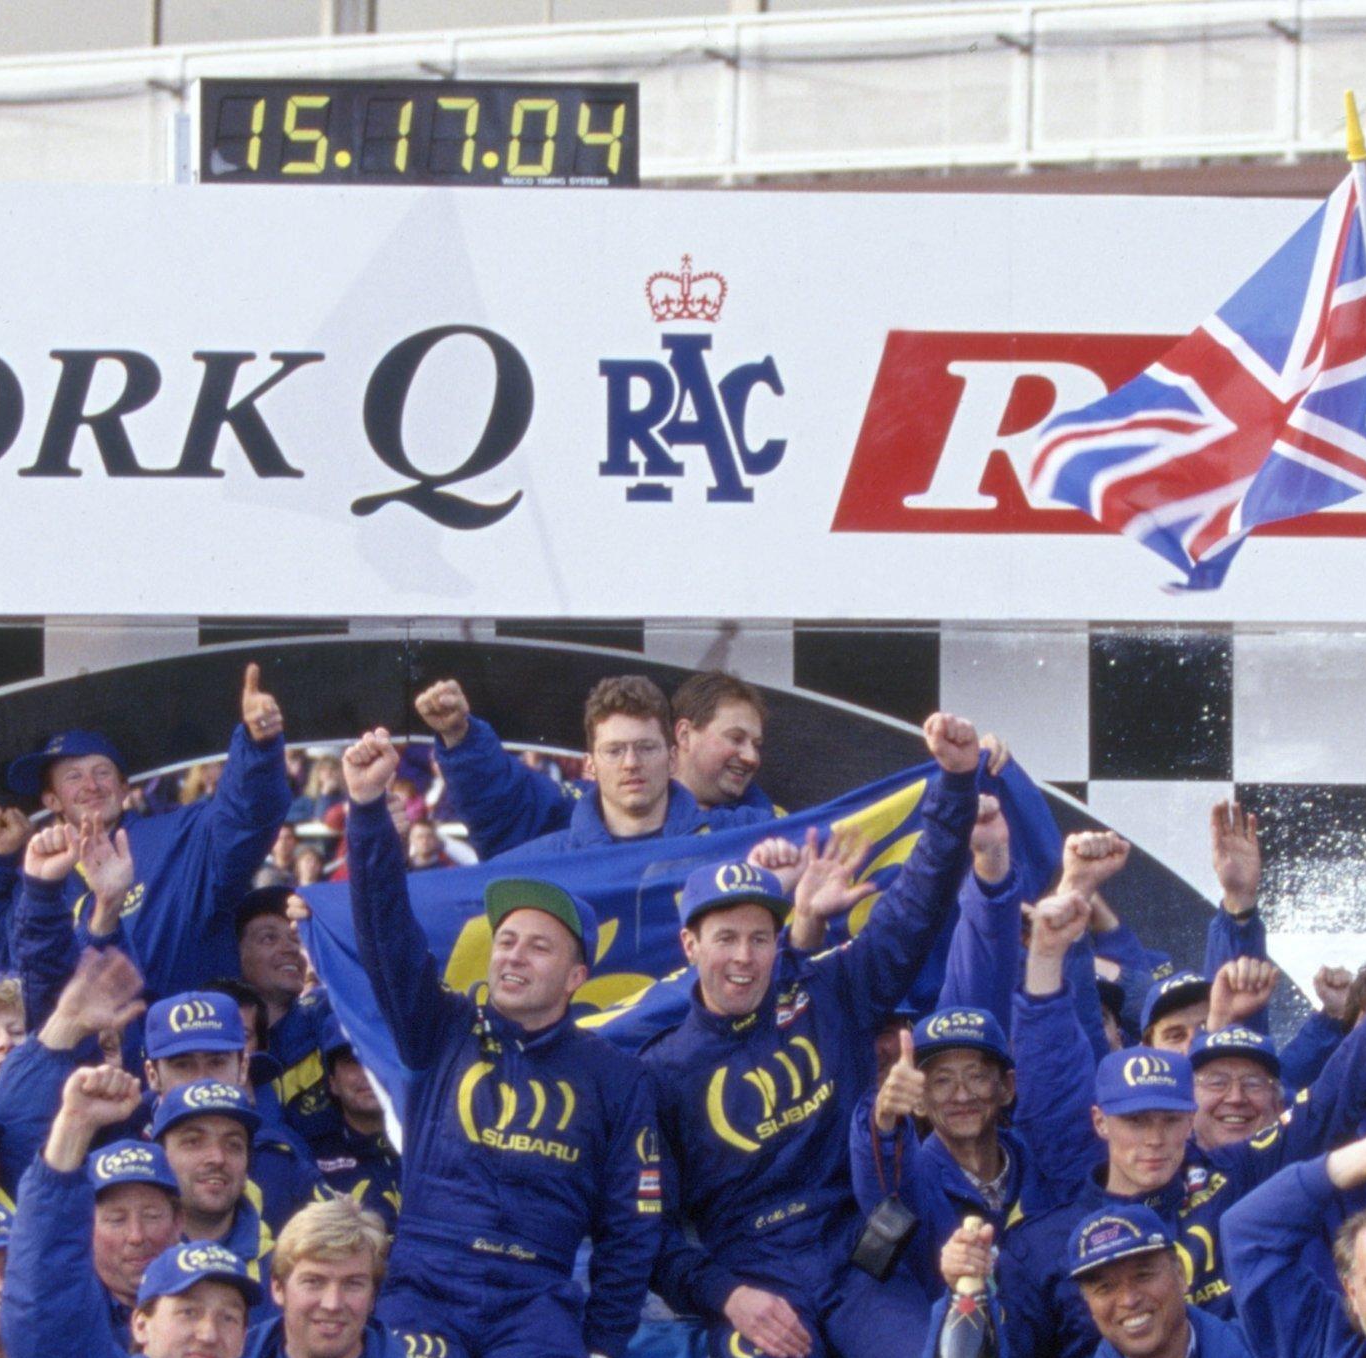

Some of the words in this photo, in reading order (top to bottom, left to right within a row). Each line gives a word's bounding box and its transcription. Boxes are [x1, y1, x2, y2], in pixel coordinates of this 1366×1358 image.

[569, 176, 610, 187] SYSTEMS
[351, 324, 536, 531] Q
[598, 333, 788, 503] RAC
[482, 1128, 580, 1163] SUBARU
